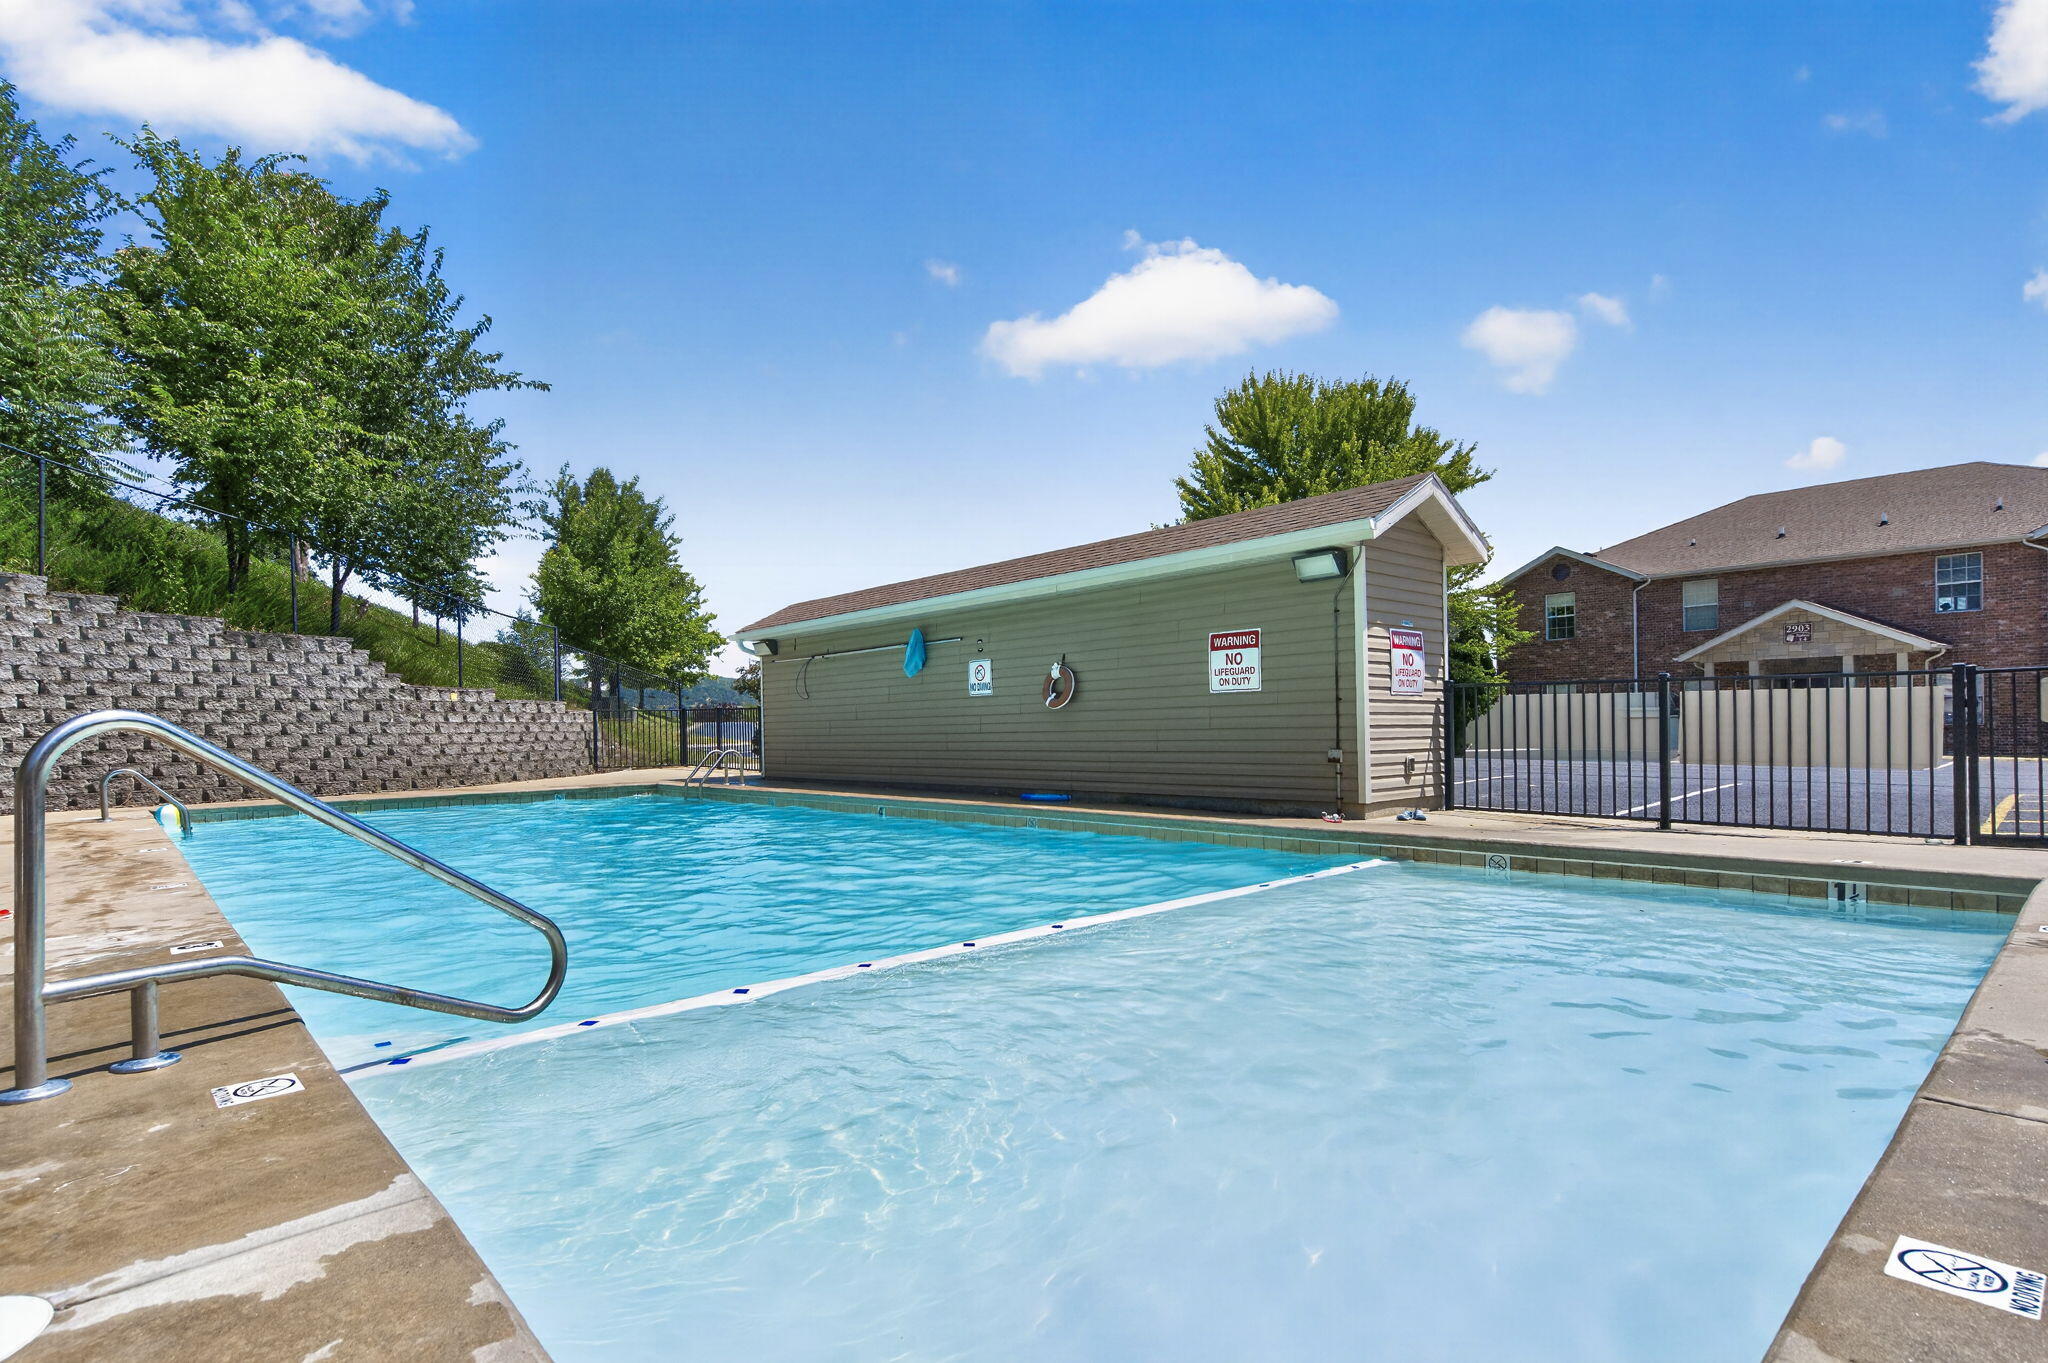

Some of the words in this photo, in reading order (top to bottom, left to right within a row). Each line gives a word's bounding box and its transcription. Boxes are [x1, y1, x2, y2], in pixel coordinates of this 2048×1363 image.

[1214, 634, 1256, 648] WARNING
[1393, 634, 1421, 647] WARNING
[1225, 652, 1243, 666] NO
[1402, 653, 1414, 667] NO
[1214, 666, 1256, 677] LIFEGUARD
[1395, 668, 1422, 678] LIFEGUARD
[1219, 677, 1230, 687] ON
[1231, 676, 1252, 686] DUTY
[1398, 679, 1406, 688] ON
[2011, 1271, 2044, 1303] DIVING
[2008, 1298, 2040, 1316] NO
